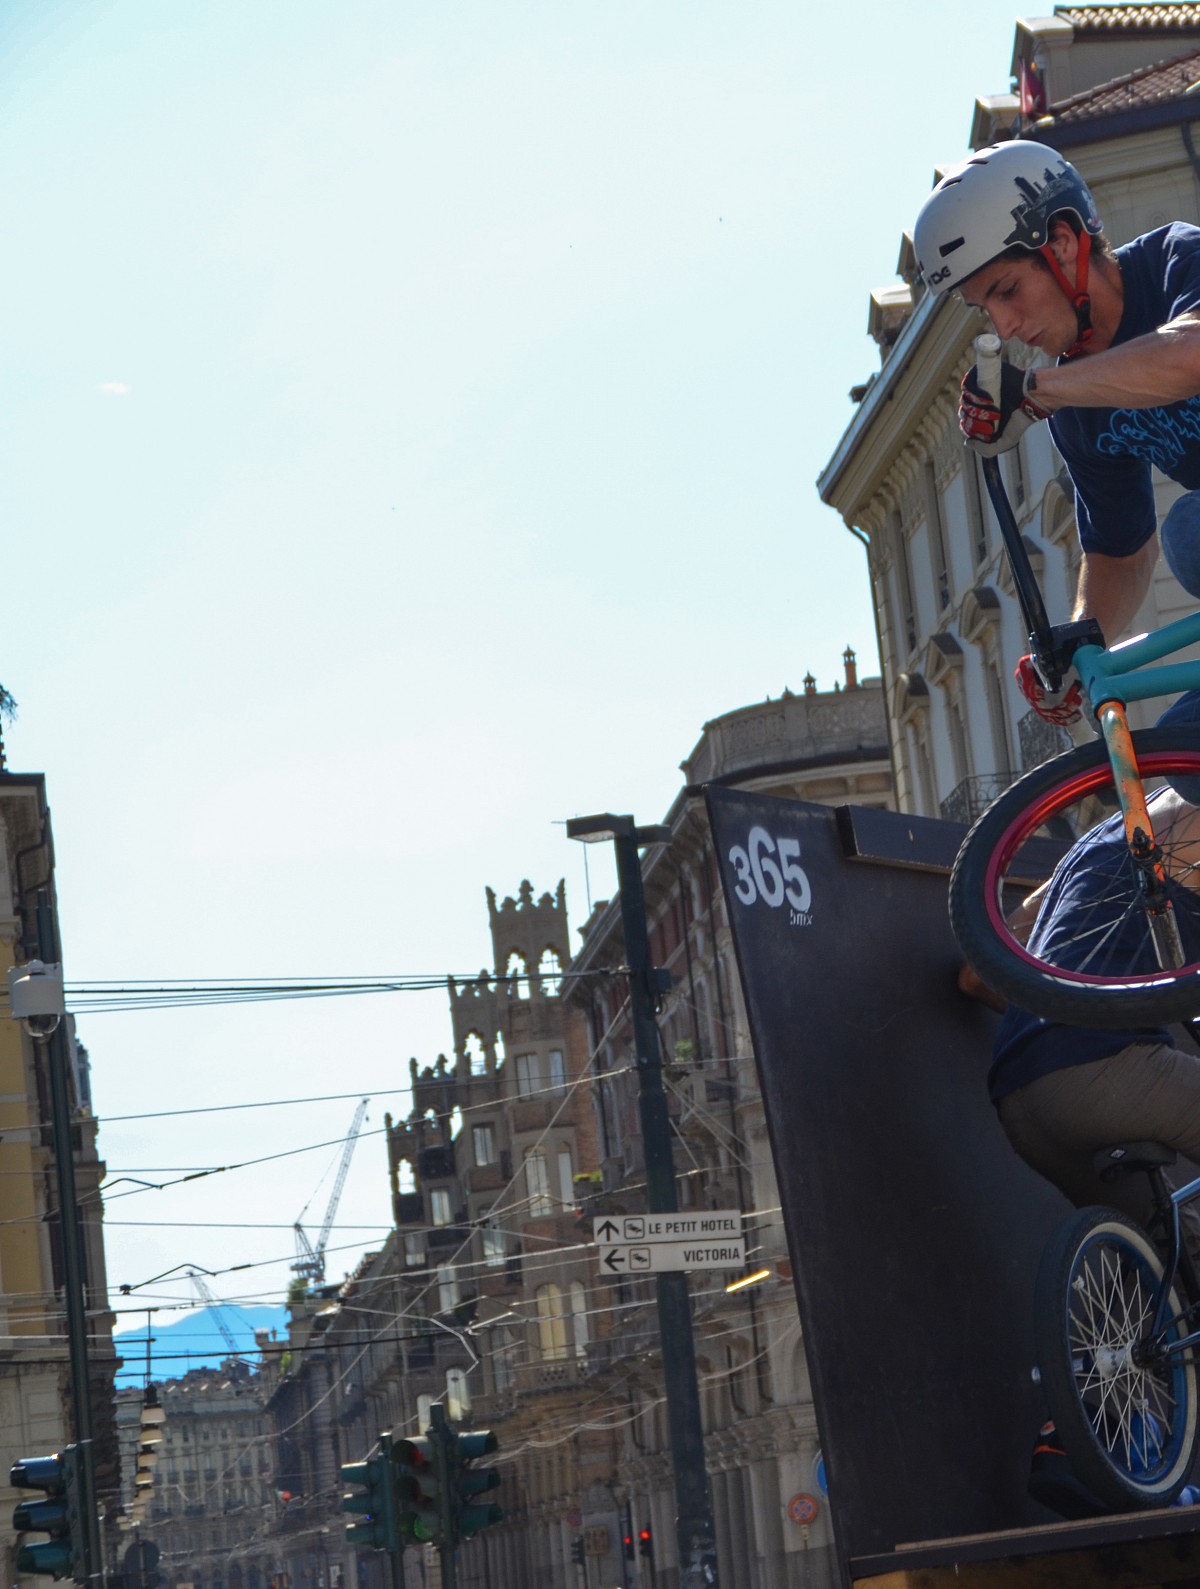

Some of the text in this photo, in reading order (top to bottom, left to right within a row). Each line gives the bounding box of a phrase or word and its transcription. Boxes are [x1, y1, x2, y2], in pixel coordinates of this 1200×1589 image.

[729, 826, 812, 912] 365
[790, 909, 813, 927] bmx
[648, 1219, 736, 1234] LE PETIT HOTEL
[684, 1248, 740, 1262] VICTORIA
